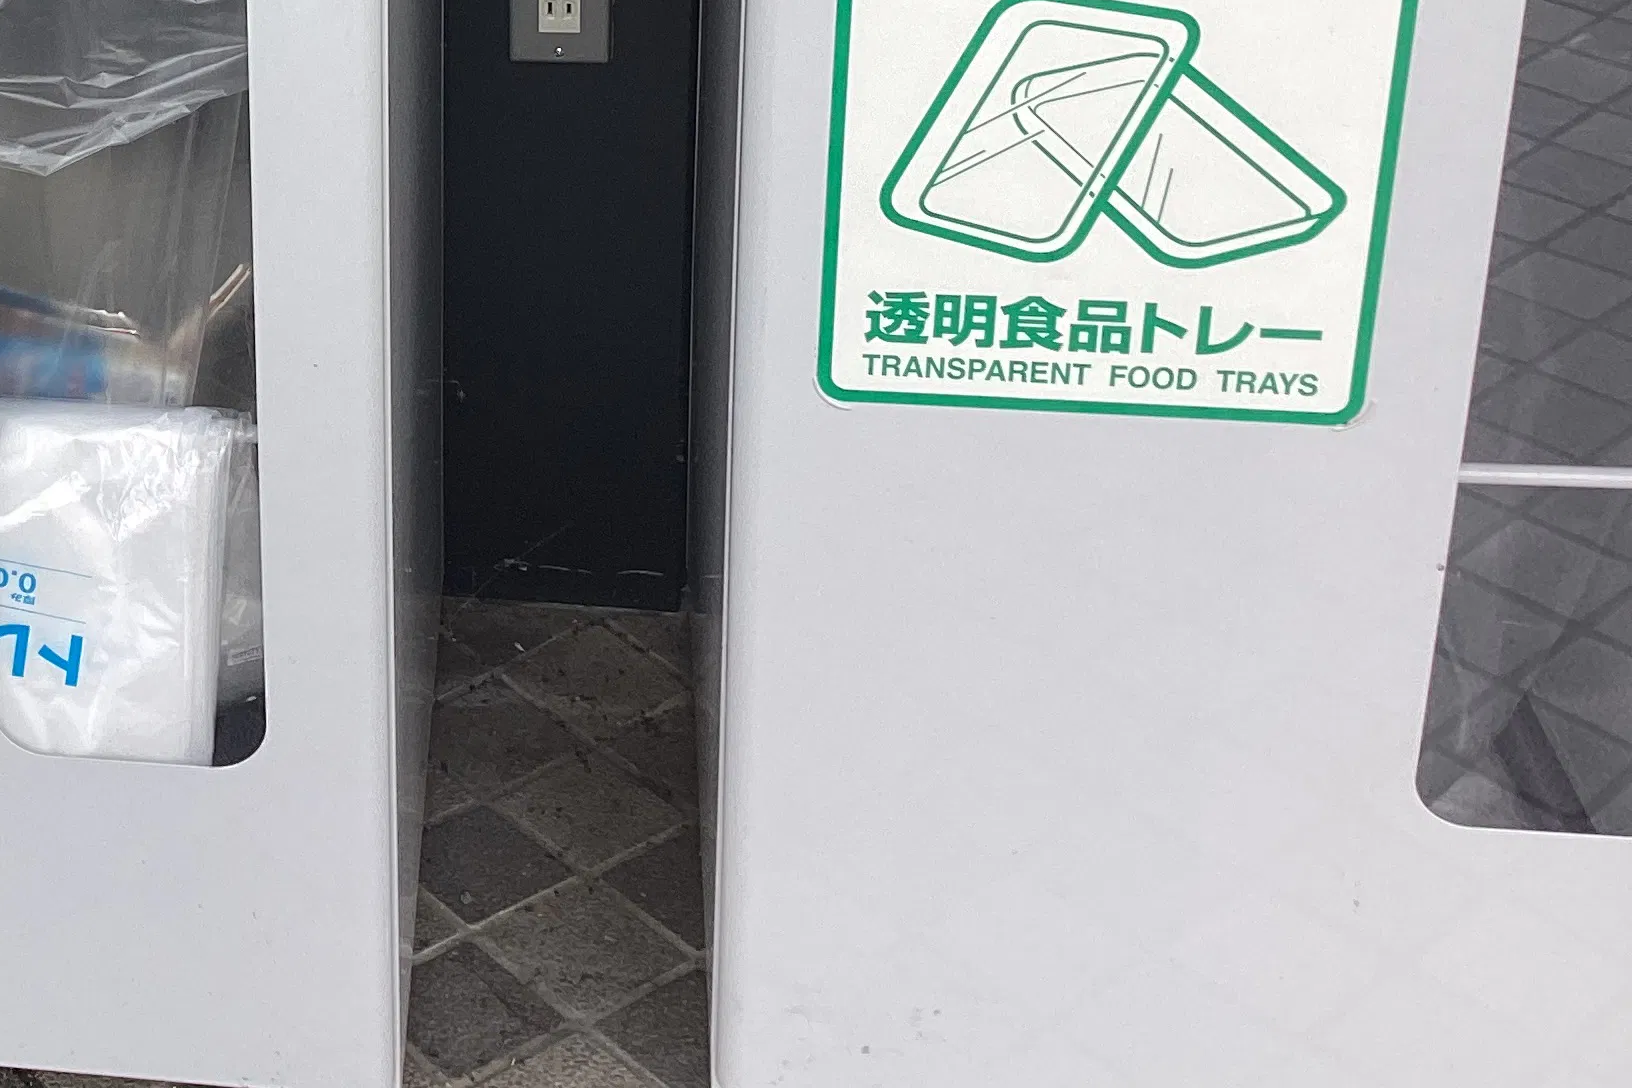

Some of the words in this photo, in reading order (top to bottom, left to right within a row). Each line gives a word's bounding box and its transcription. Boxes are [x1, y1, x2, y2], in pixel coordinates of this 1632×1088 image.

[864, 290, 1323, 355] 透明食品トレー
[862, 352, 1092, 386] TRANSPARENT
[1109, 365, 1198, 391] FOOD
[1216, 369, 1320, 397] TRAYS
